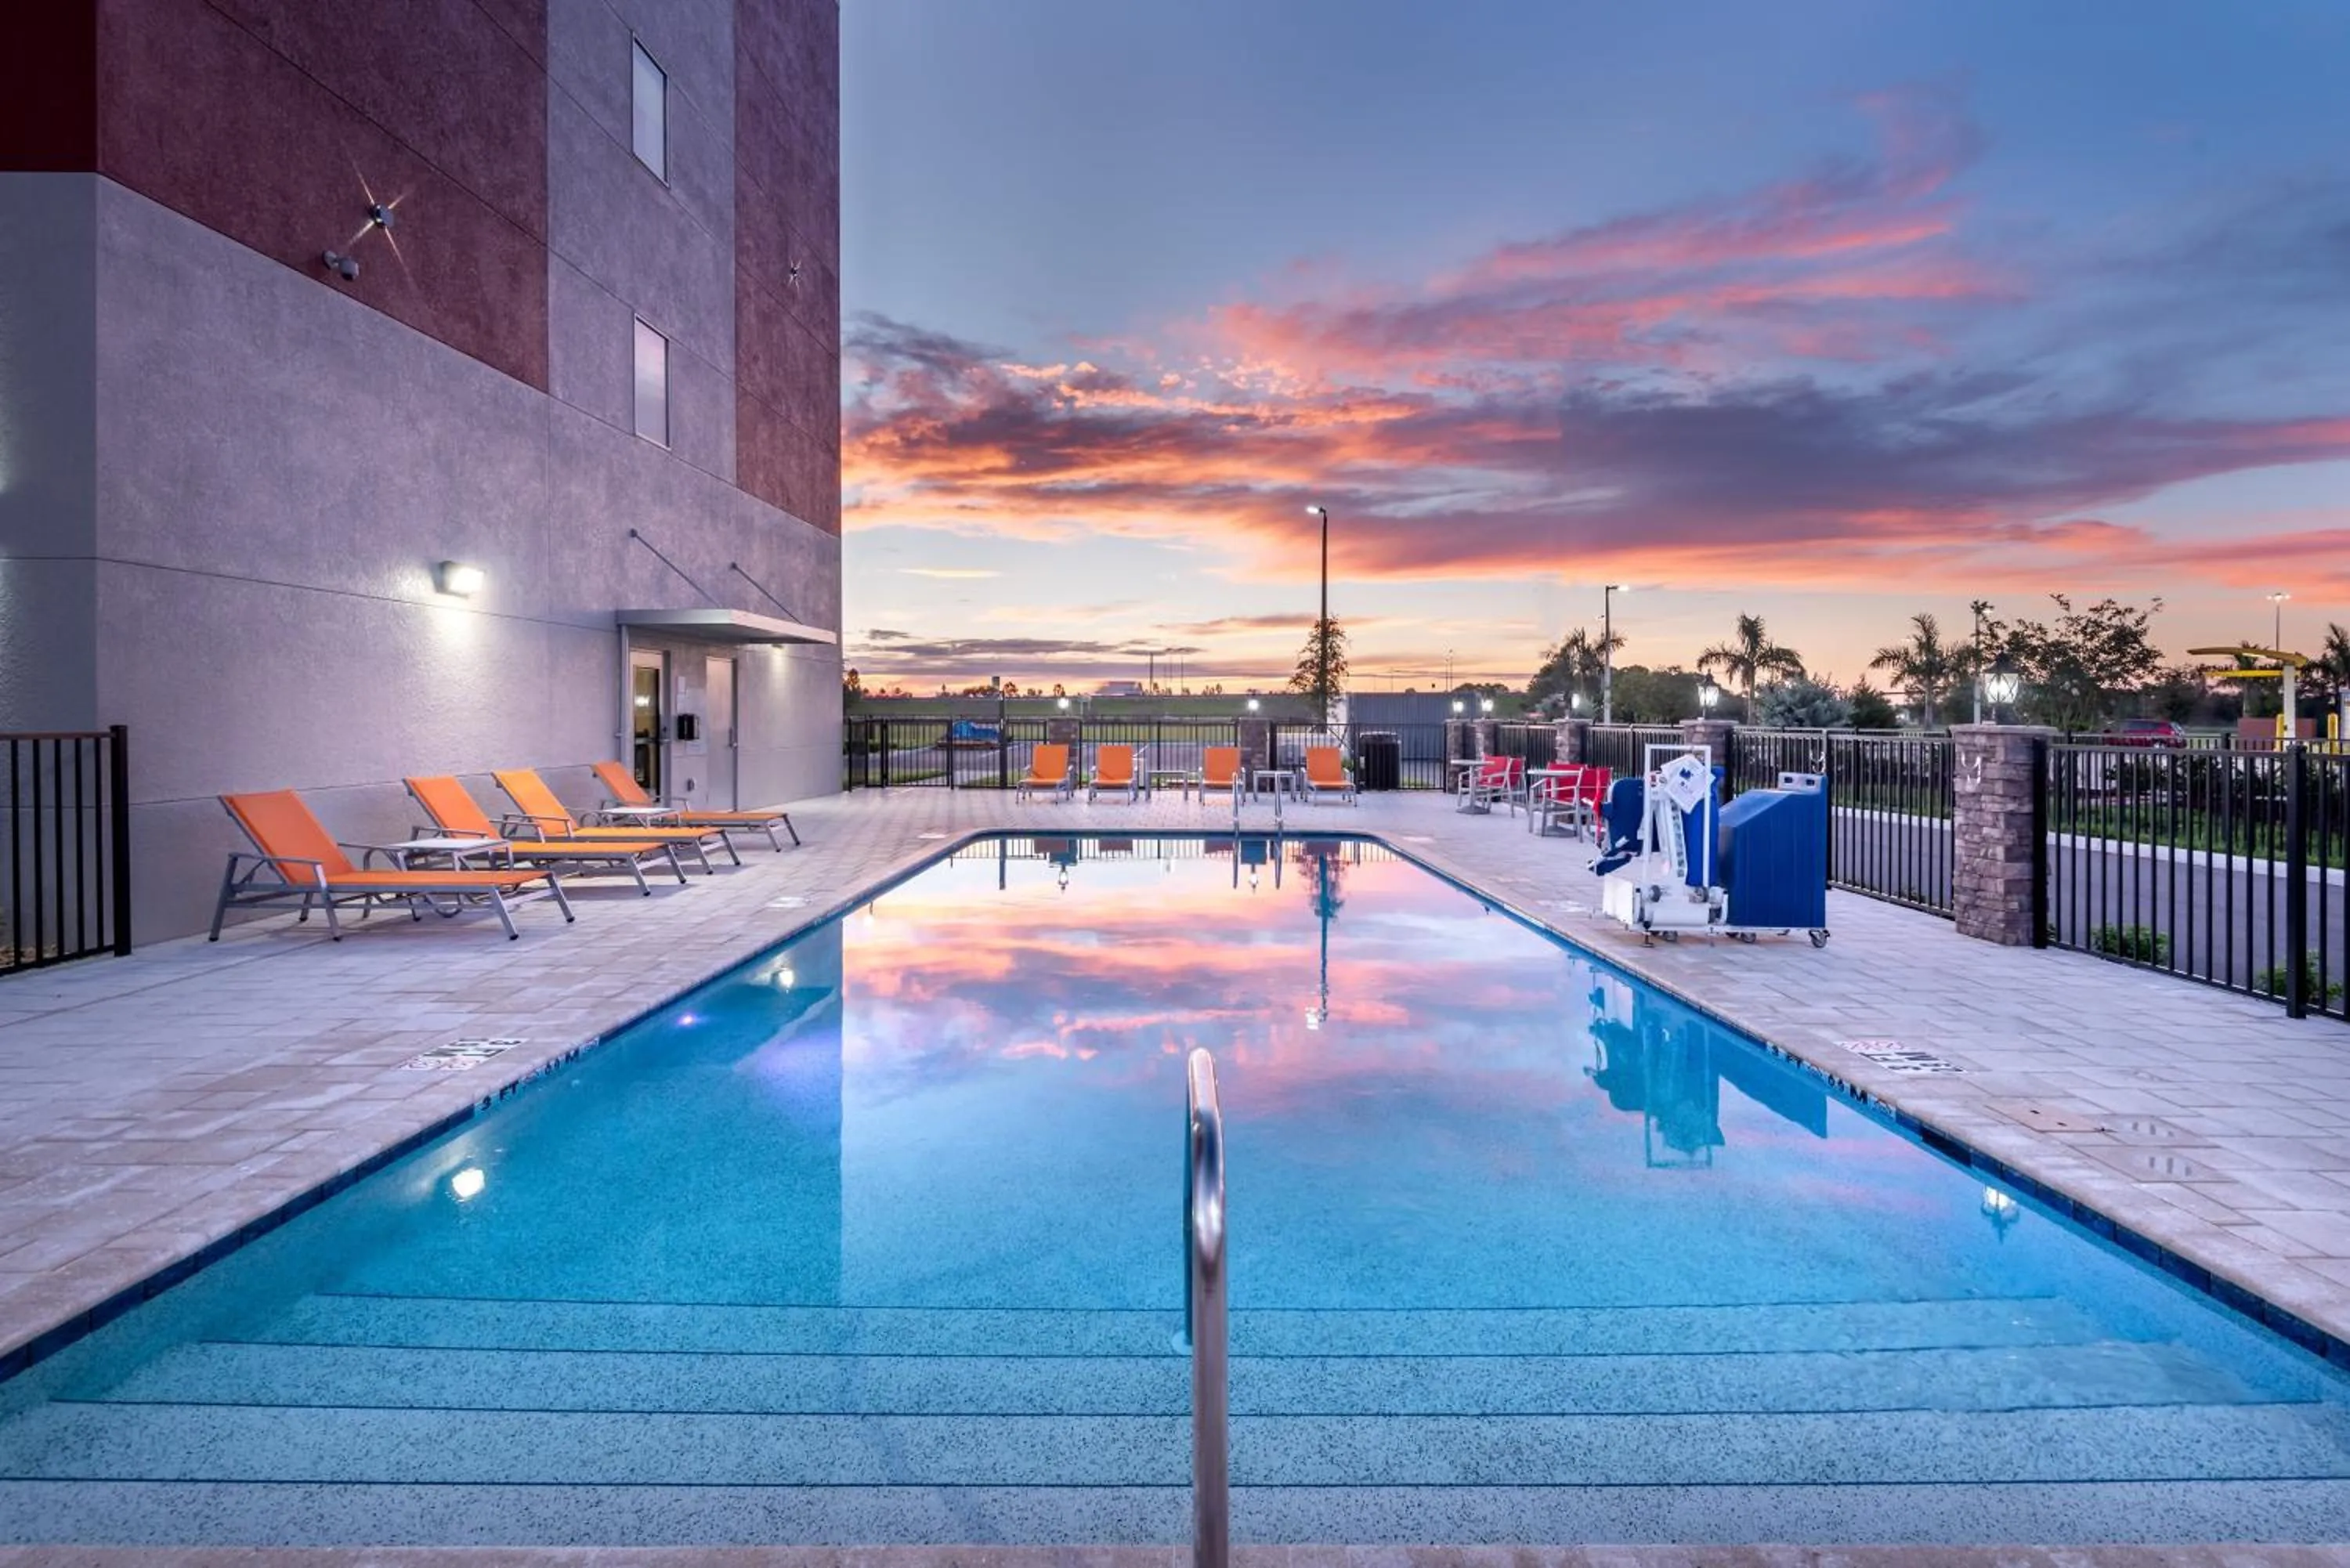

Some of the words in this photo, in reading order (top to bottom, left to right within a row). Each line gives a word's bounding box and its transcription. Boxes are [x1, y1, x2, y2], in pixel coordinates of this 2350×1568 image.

[499, 1079, 519, 1100] FT
[1786, 1051, 1802, 1069] FT
[1849, 1083, 1868, 1105] M
